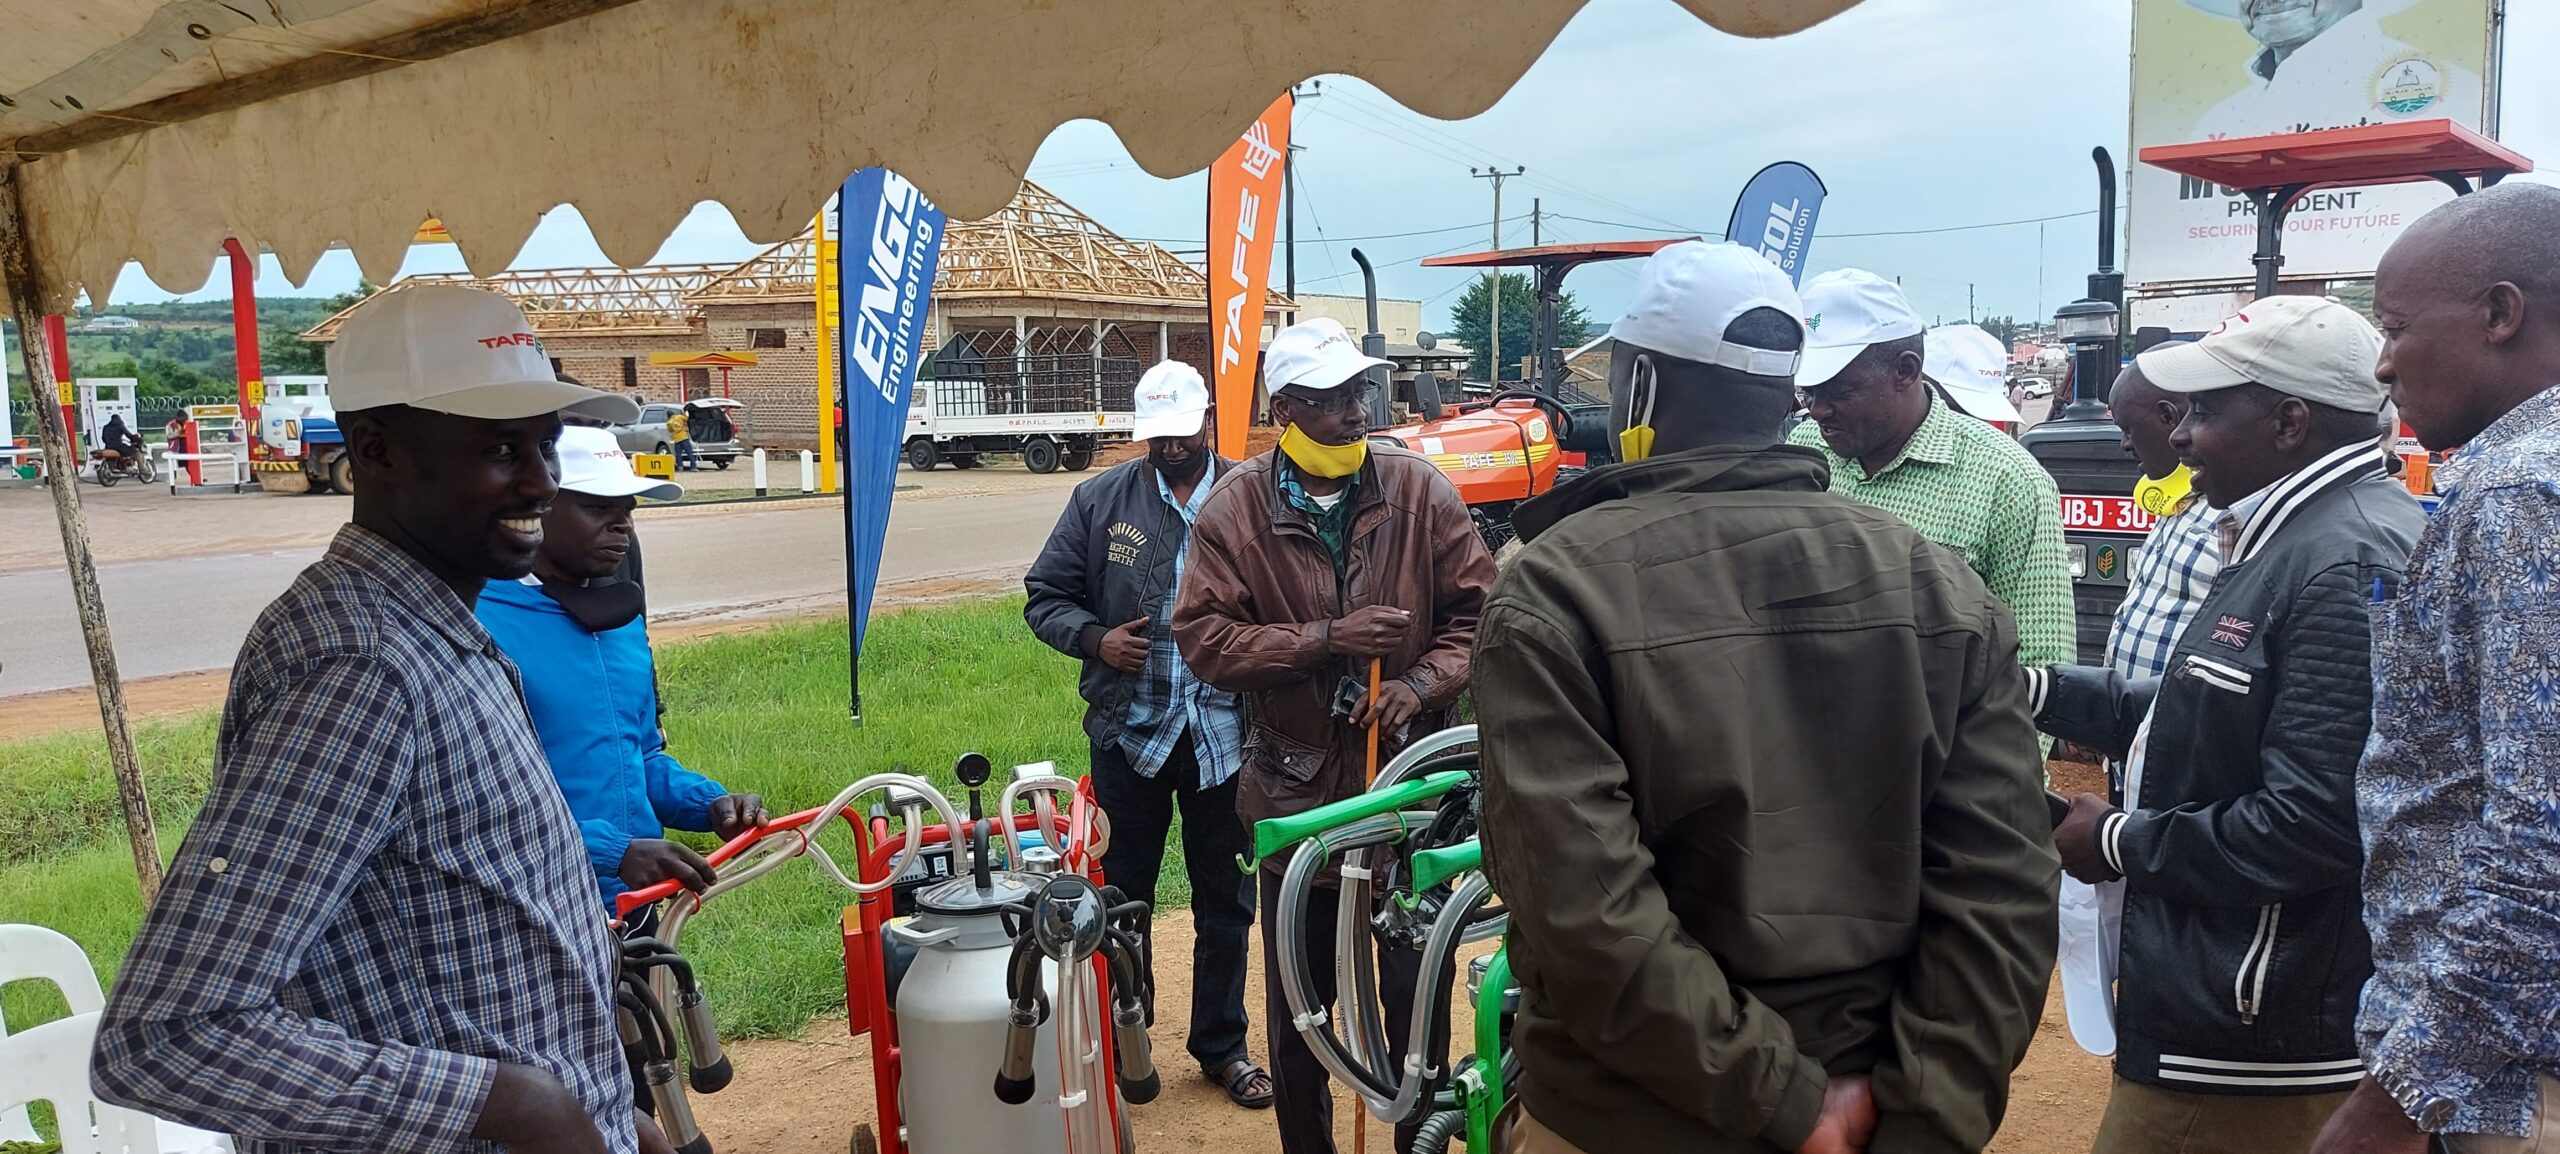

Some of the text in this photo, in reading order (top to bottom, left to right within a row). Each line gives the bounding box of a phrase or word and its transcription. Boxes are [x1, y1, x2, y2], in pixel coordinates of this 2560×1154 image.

[2228, 191, 2362, 217] PRDENT
[1783, 208, 1811, 270] Solution
[2188, 223, 2257, 239] SECURIN
[2329, 213, 2401, 230] FUTURE
[1220, 187, 1260, 376] TAFE
[882, 218, 933, 405] Engineering
[478, 333, 534, 349] TAFE
[1460, 453, 1496, 469] TAFE
[2116, 501, 2157, 529] 30
